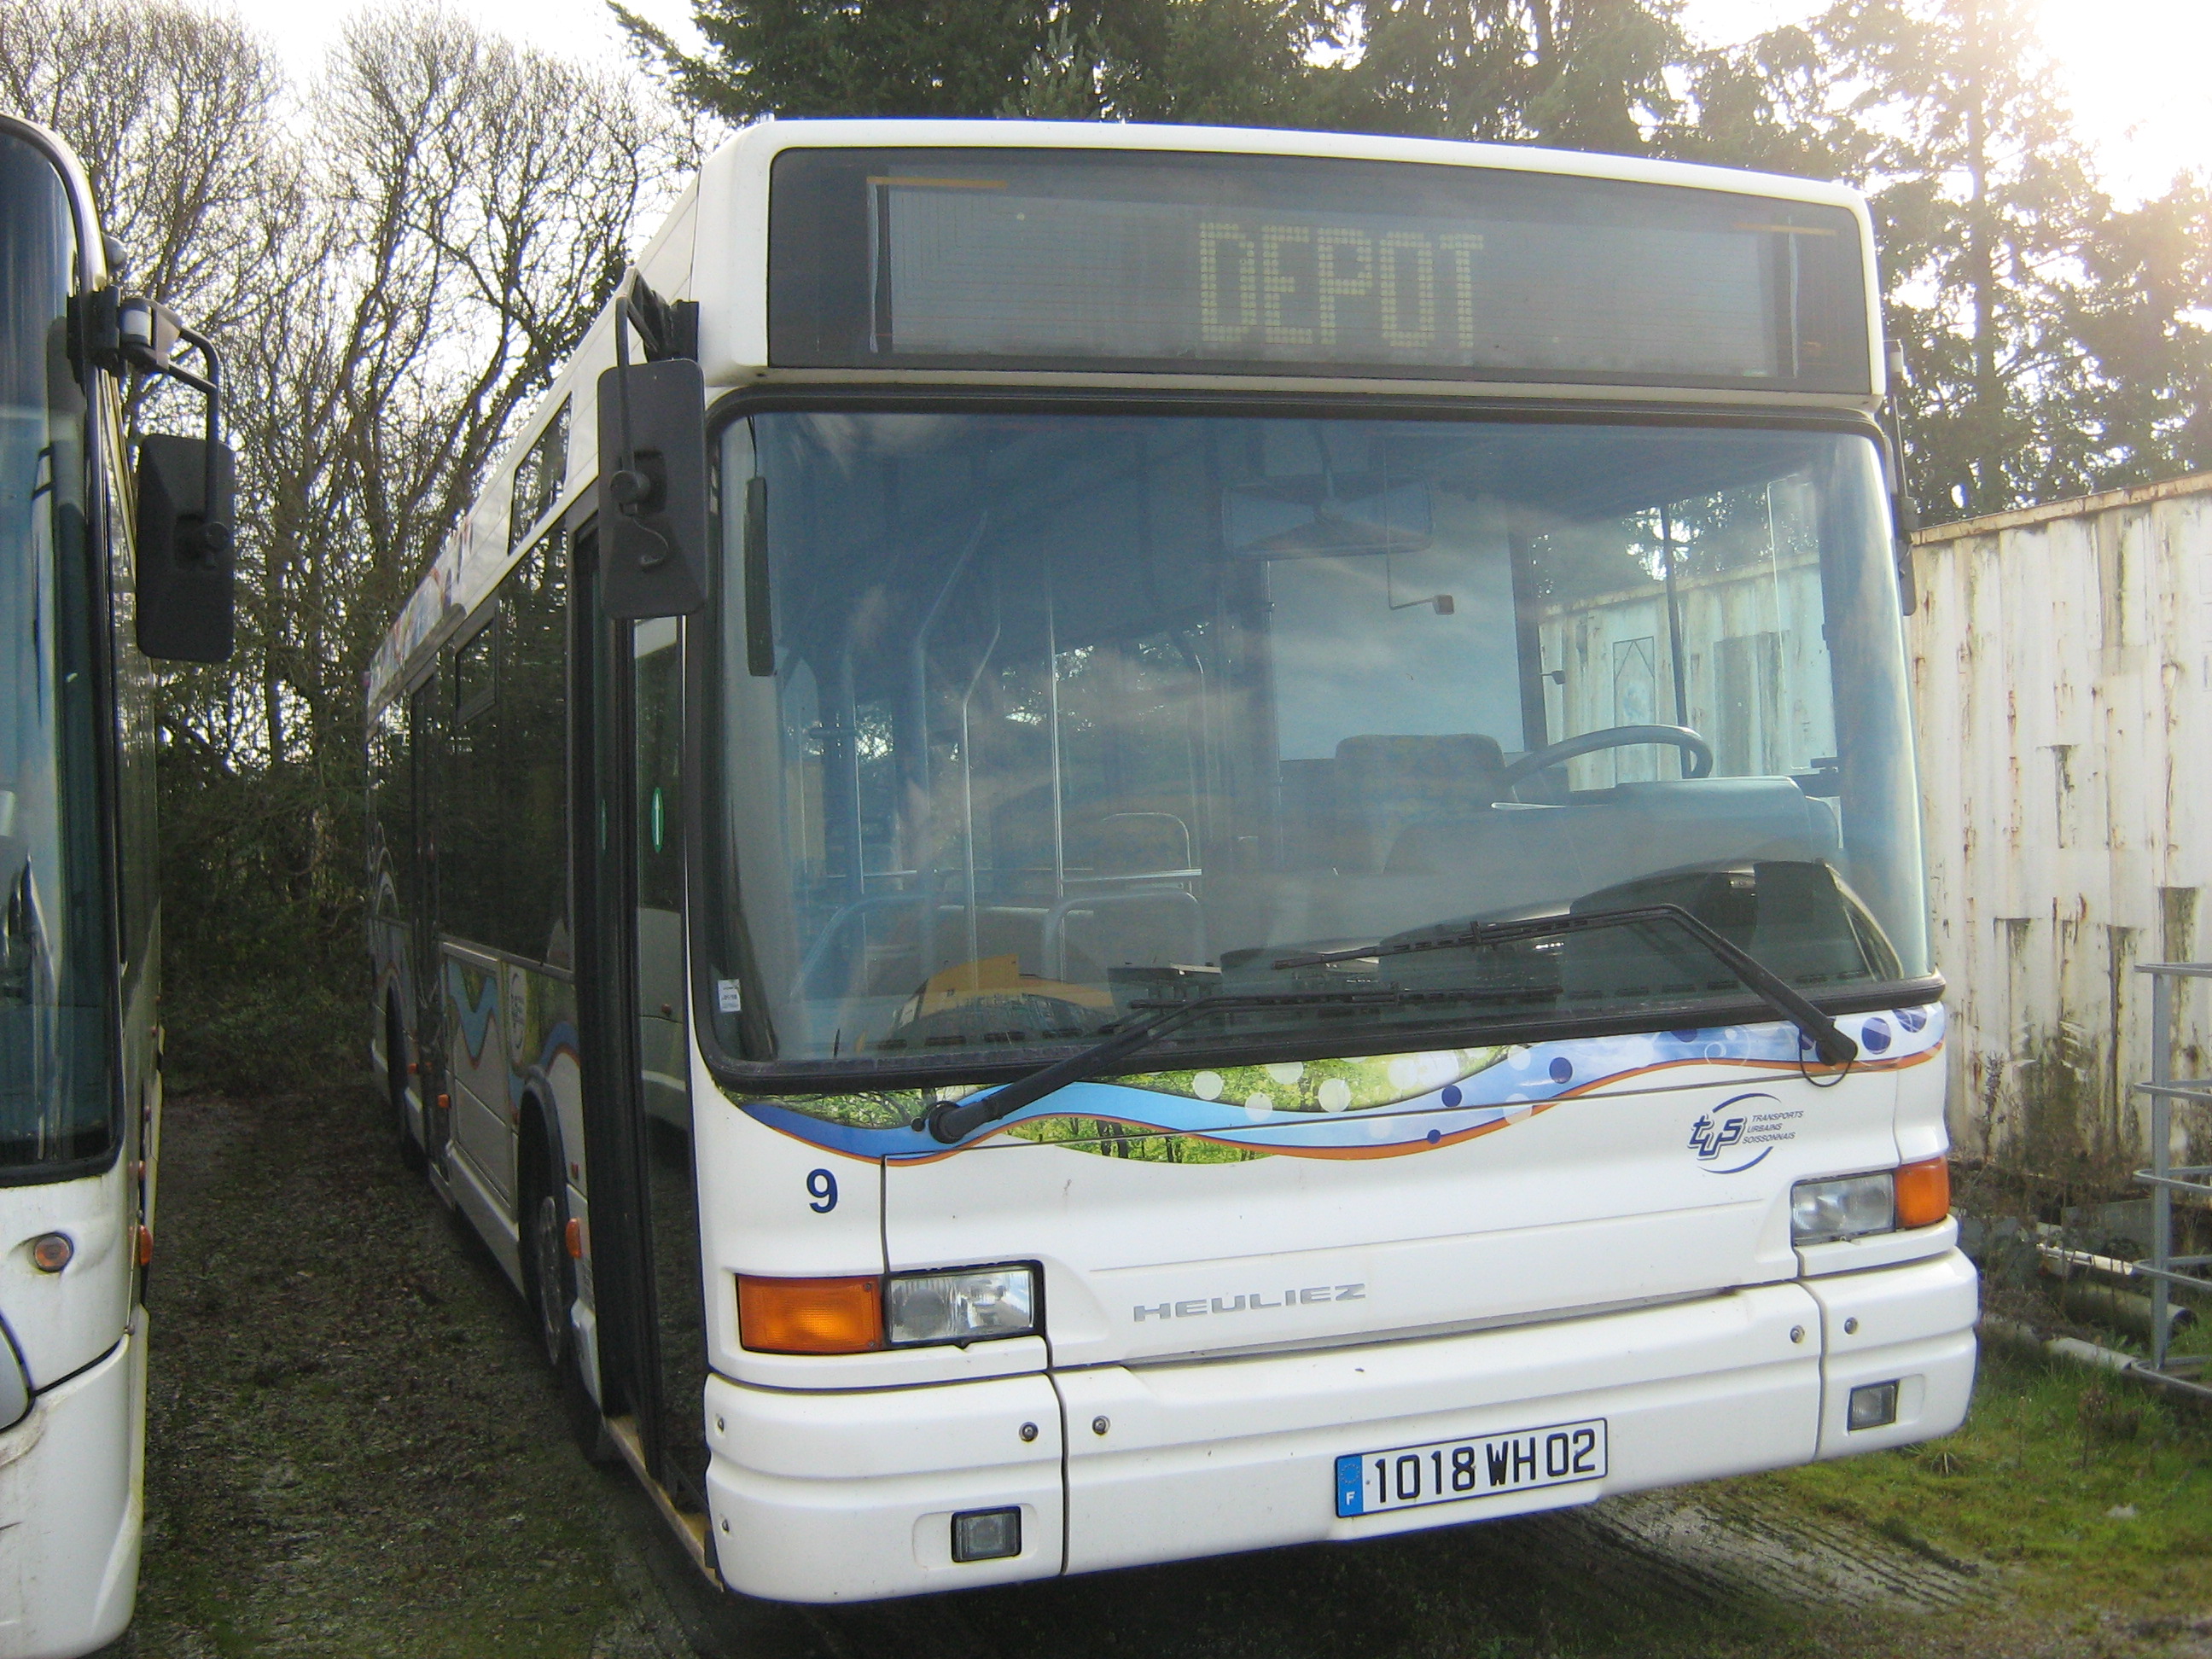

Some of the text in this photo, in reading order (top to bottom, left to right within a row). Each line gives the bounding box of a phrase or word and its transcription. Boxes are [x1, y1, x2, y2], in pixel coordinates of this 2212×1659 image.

[1199, 222, 1484, 348] DEPOT
[1752, 1110, 1804, 1122] TRANSPORTS
[1747, 1123, 1783, 1133] URBAINS
[1742, 1132, 1796, 1144] SOISSONNAIS
[806, 1167, 838, 1214] 9
[1133, 1283, 1366, 1322] HEULIEZ
[1345, 1490, 1355, 1506] F
